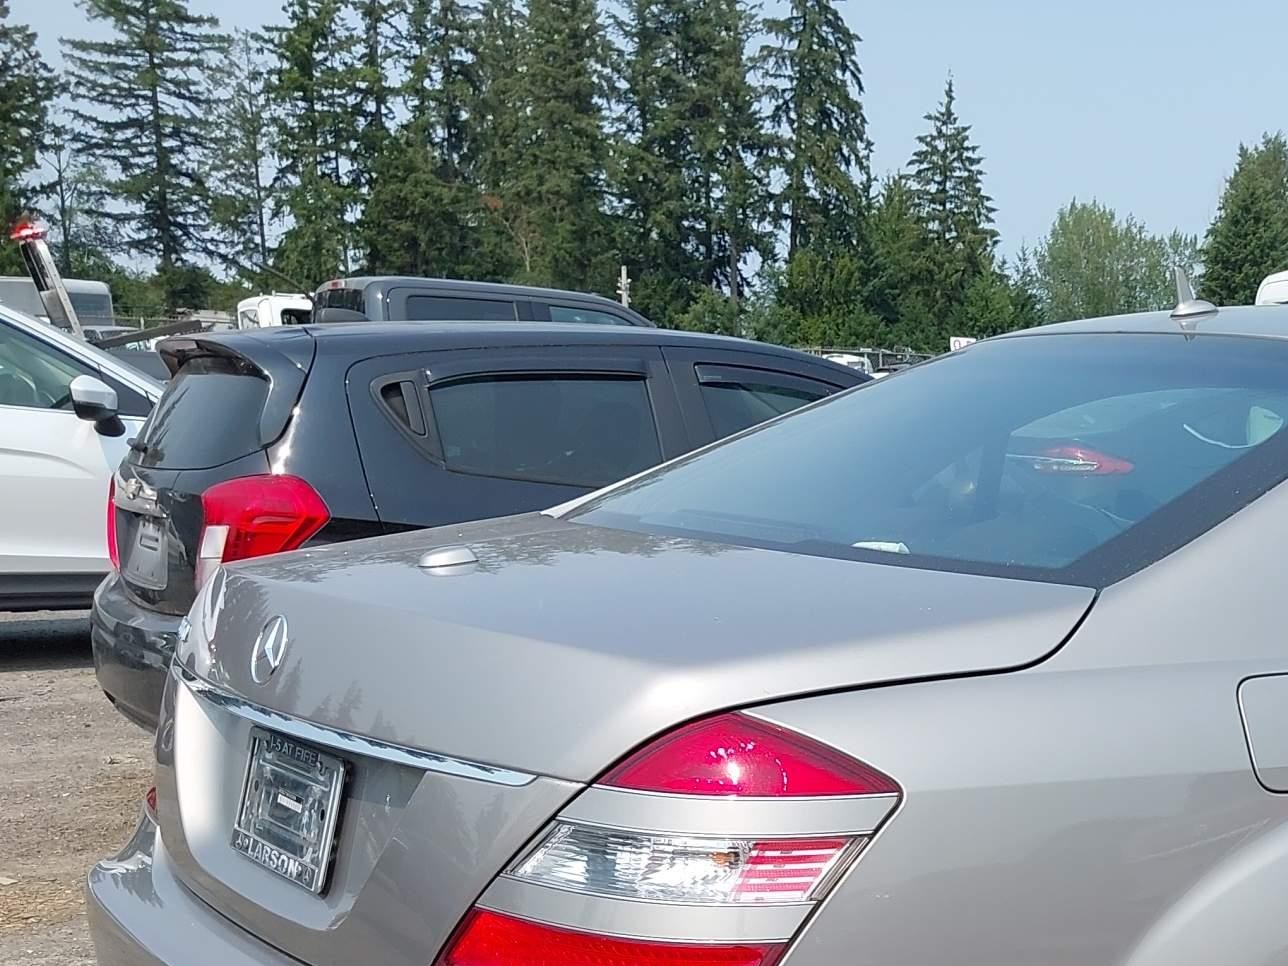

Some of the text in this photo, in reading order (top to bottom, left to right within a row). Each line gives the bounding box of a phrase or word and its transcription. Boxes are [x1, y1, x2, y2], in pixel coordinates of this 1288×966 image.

[281, 742, 294, 755] AT
[295, 747, 317, 767] FIFE
[247, 837, 300, 878] LARSON
